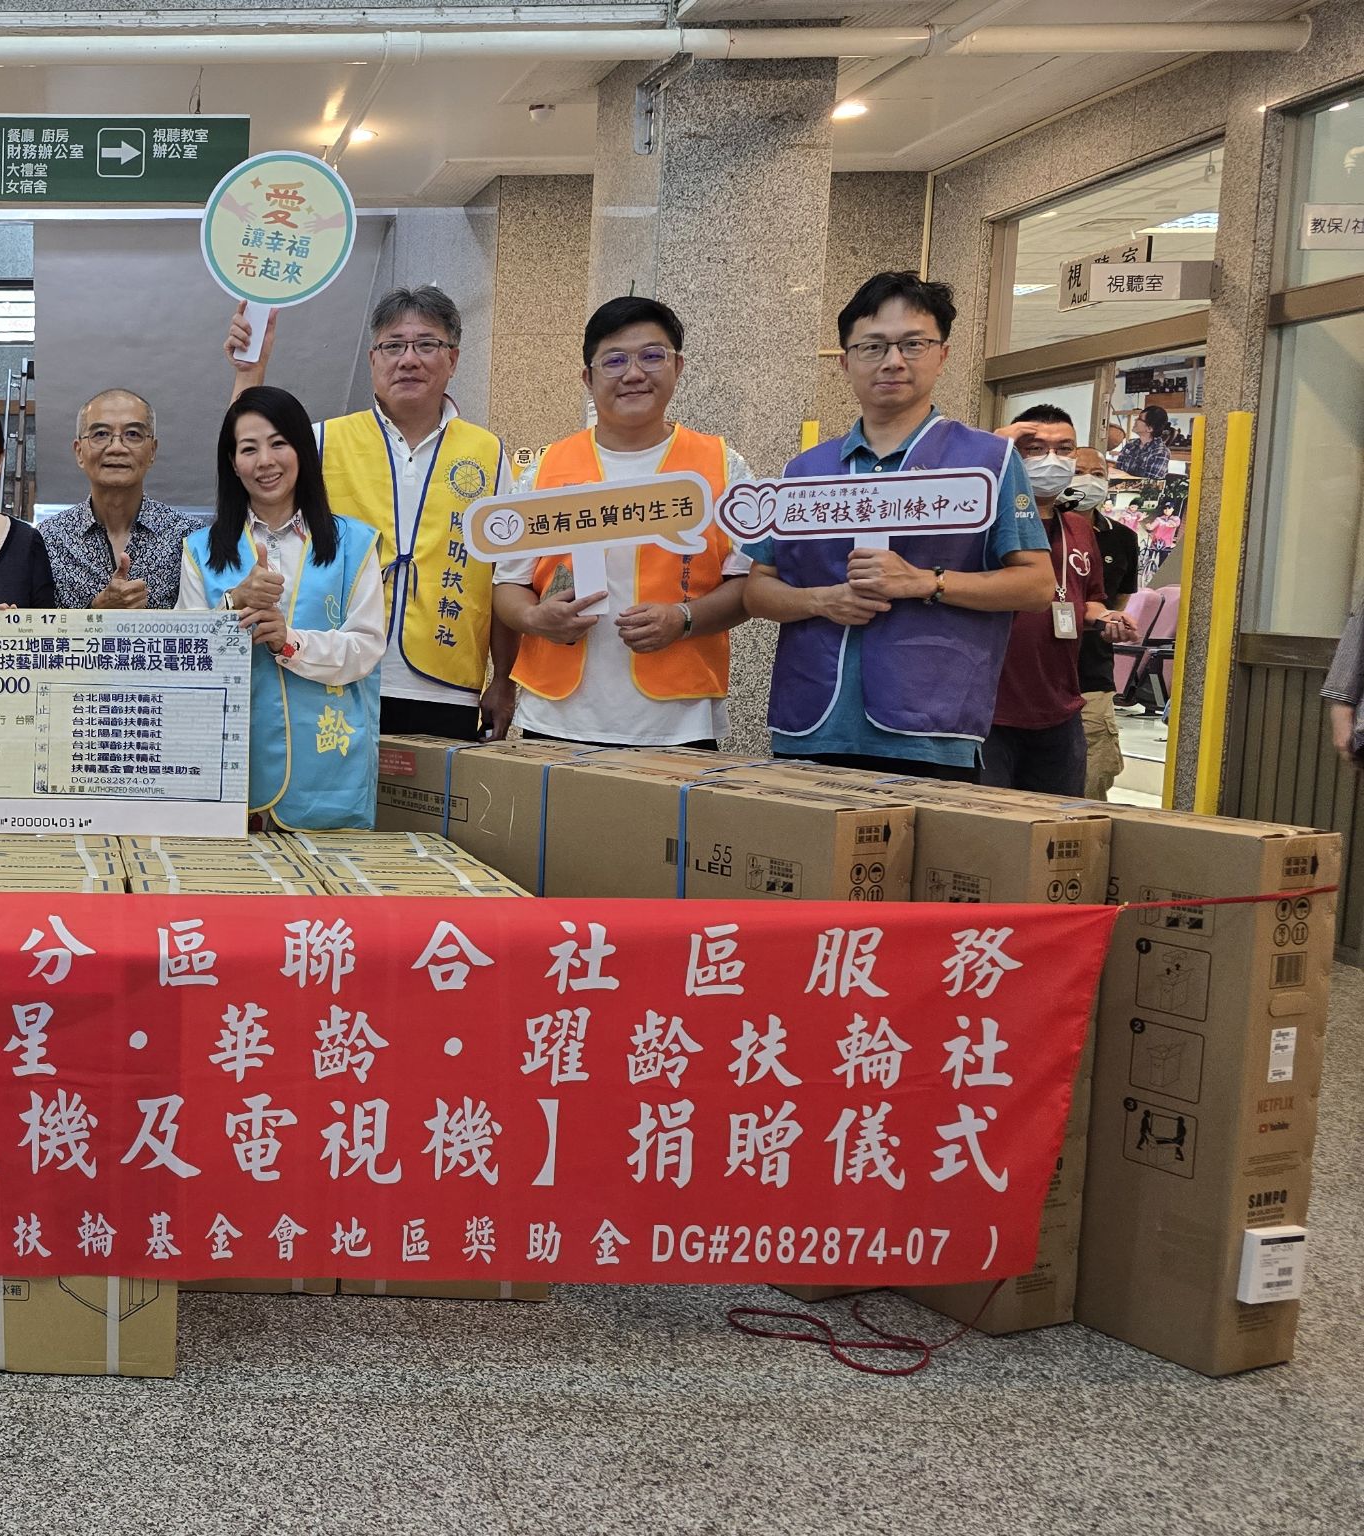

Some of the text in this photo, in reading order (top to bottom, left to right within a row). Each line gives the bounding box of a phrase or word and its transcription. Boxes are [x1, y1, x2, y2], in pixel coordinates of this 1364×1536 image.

[7, 128, 34, 143] 餐廳
[41, 128, 69, 143] 廚房
[152, 128, 209, 144] 視聽教室
[7, 144, 84, 160] 財務辦公室
[152, 143, 198, 159] 辦公室
[6, 163, 48, 178] 大禮堂
[6, 180, 48, 194] 女宿舍
[262, 181, 306, 229] 愛
[241, 224, 312, 259] 讓幸福
[236, 252, 303, 285] 亮起來
[1107, 274, 1164, 293] 視聽室
[516, 449, 531, 464] 意
[527, 496, 693, 536] 過有品質的生活
[783, 495, 979, 525] 啟智技藝訓練中心
[1014, 510, 1035, 519] otary
[5, 614, 20, 624] 10
[41, 614, 56, 624] 17
[227, 638, 240, 647] 22
[72, 694, 164, 703] 台北陽明扶輪社
[72, 705, 163, 715] 台北百齡扶輪社
[72, 717, 163, 727] 台北福齡扶輪社
[72, 729, 163, 739] 台北陽星扶輪社
[72, 741, 162, 751] 台北華齡扶輪社
[72, 753, 162, 763] 台北躍齡扶輪社
[71, 764, 201, 776] 扶輪基金會地區獎助金
[71, 776, 156, 785] DG#2682874-07
[129, 786, 164, 794] SIGNATURE
[712, 844, 732, 864] 55
[696, 859, 732, 877] LED
[1256, 1096, 1294, 1114] NETFLIX
[1247, 1189, 1288, 1209] SAMPO
[651, 1223, 950, 1266] DG#2682874-07
